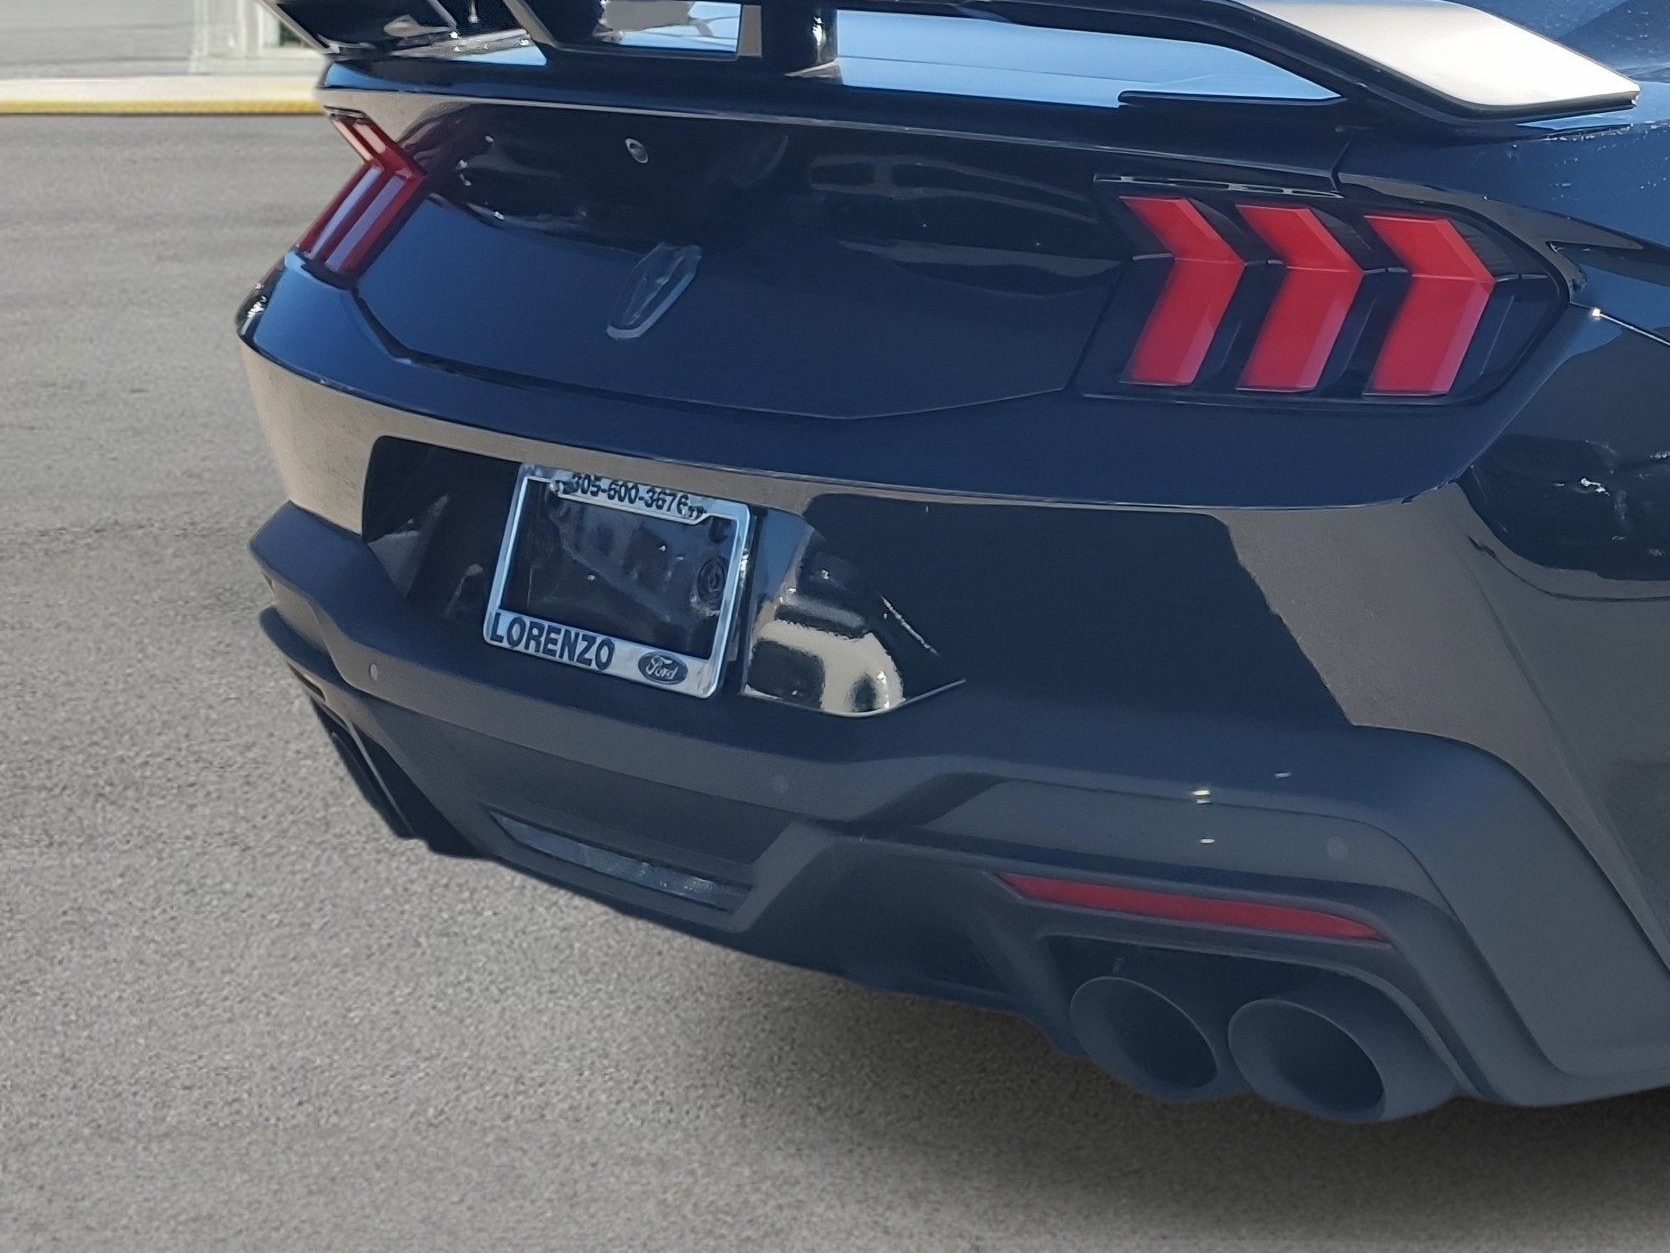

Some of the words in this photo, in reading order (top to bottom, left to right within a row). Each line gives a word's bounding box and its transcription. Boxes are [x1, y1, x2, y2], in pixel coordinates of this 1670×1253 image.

[572, 473, 690, 516] 305-600-3676
[489, 611, 616, 671] LORENZO
[645, 655, 679, 679] Ford
